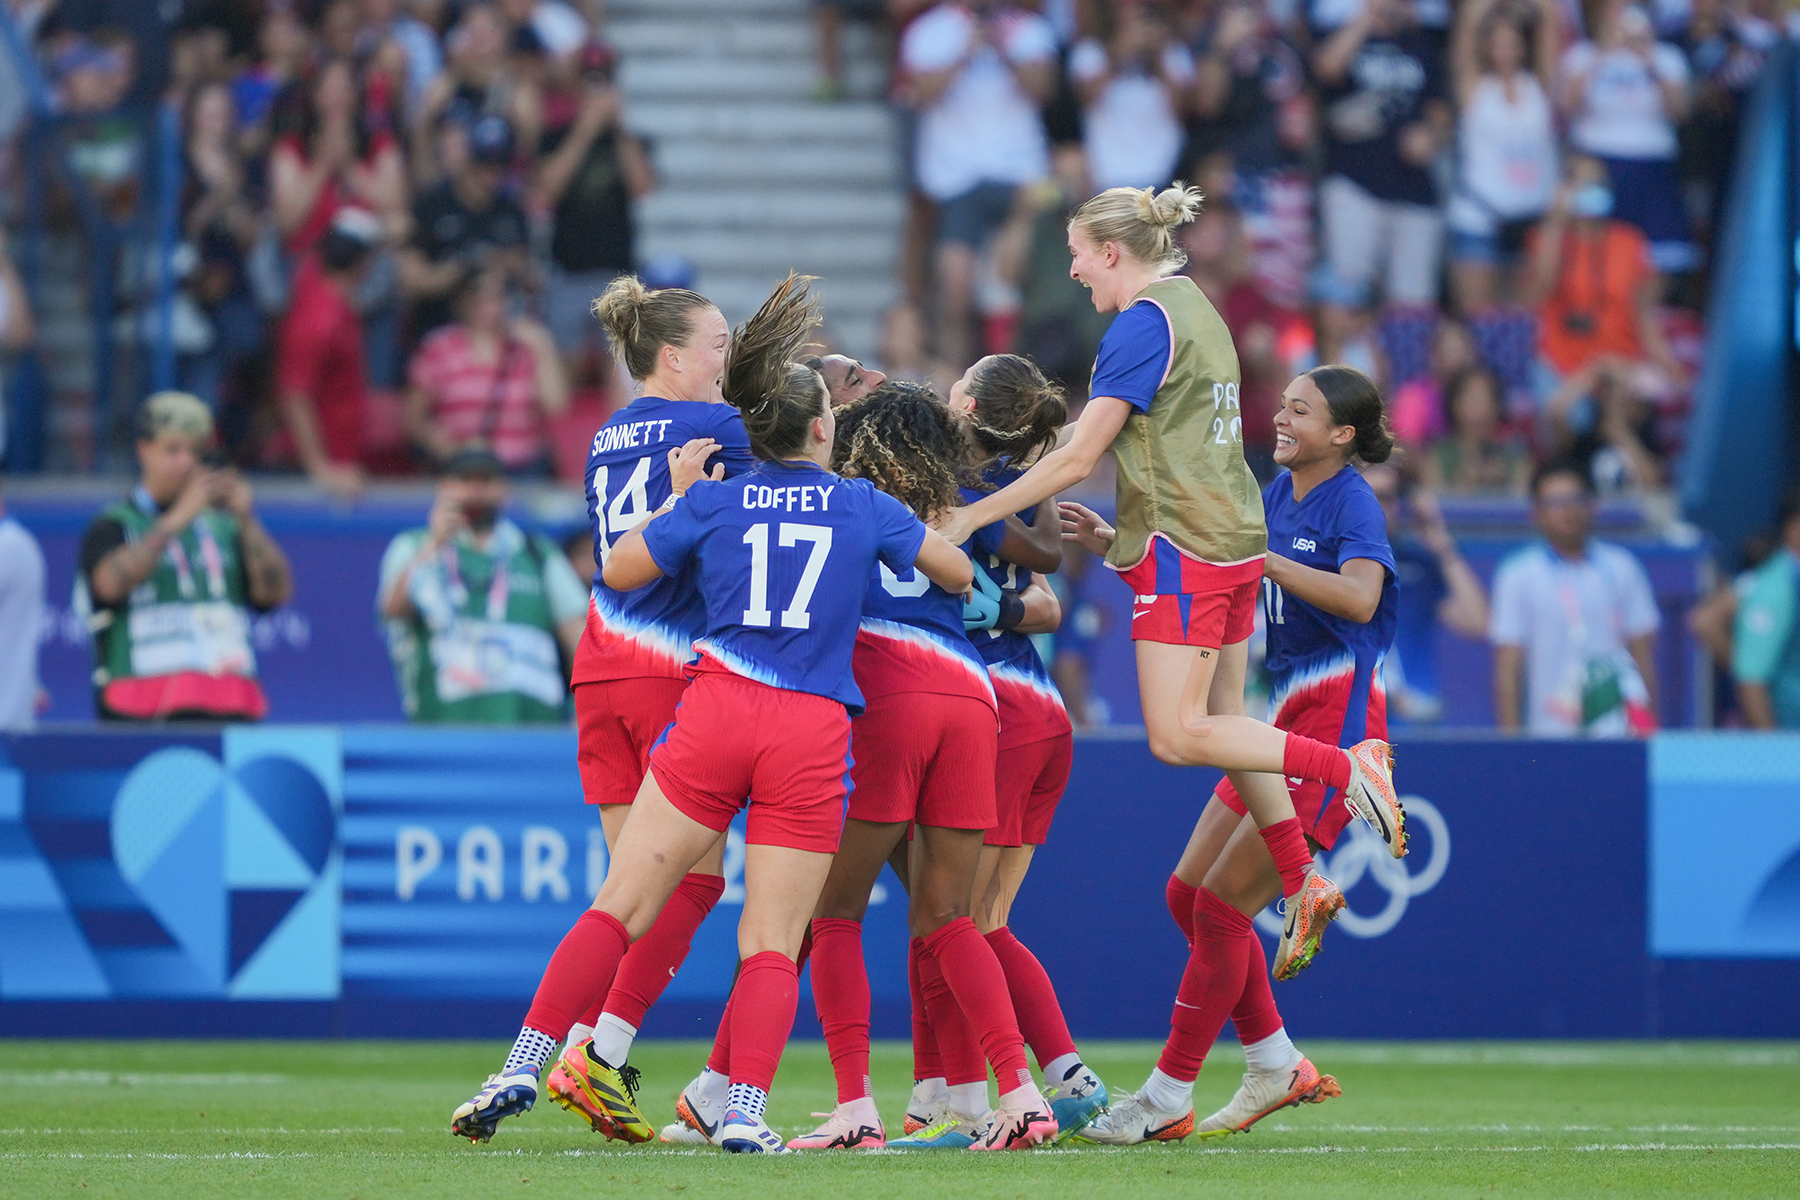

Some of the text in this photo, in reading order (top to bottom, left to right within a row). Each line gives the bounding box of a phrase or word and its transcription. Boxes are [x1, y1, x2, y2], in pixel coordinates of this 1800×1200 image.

[592, 419, 673, 457] SONNETT
[593, 457, 653, 567] 14
[743, 484, 835, 512] COFFEY
[1292, 537, 1317, 553] USA
[742, 522, 833, 630] 17
[1262, 576, 1285, 625] 11
